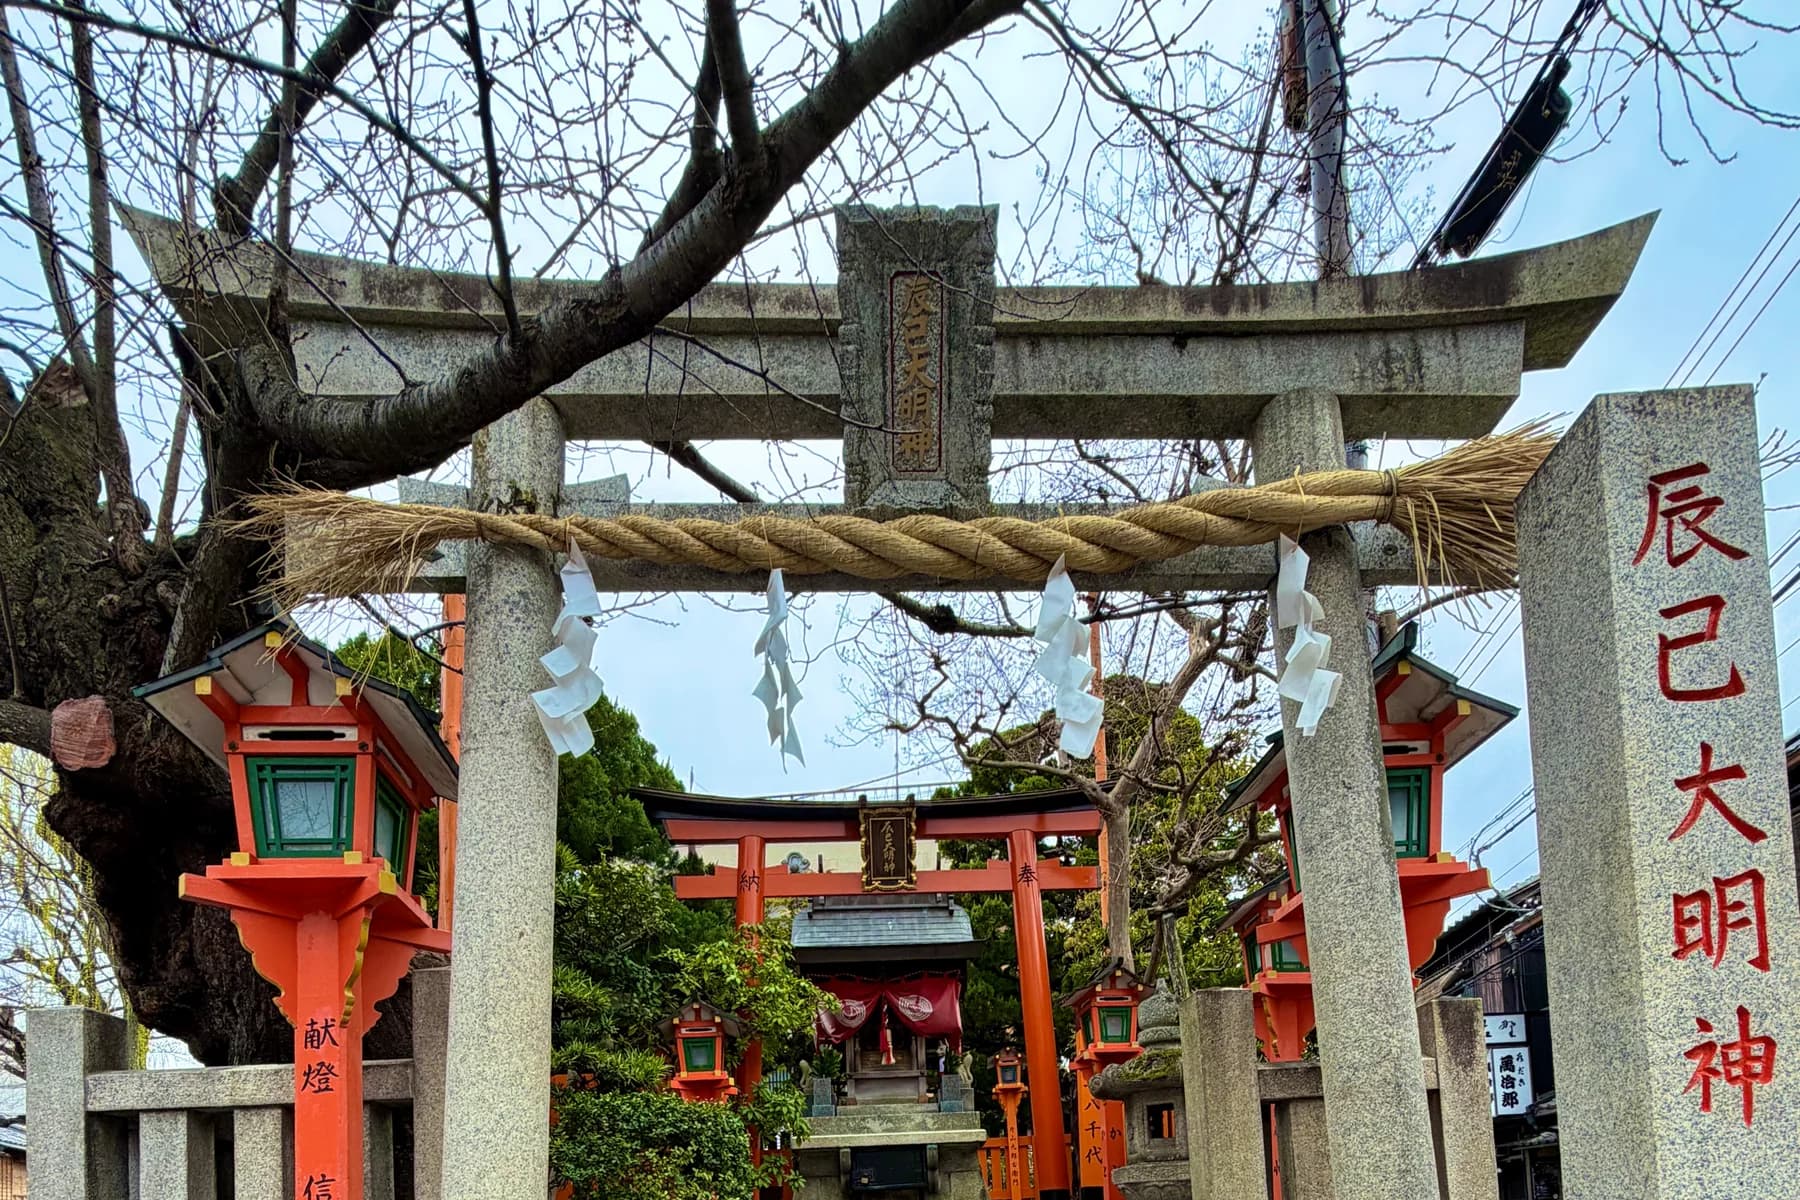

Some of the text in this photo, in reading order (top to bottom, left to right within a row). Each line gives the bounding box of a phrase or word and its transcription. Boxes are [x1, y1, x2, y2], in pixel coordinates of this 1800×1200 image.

[740, 869, 760, 894] 納
[1017, 861, 1039, 888] 奉
[302, 1018, 339, 1096] 献燈
[1083, 1083, 1103, 1164] 八千代
